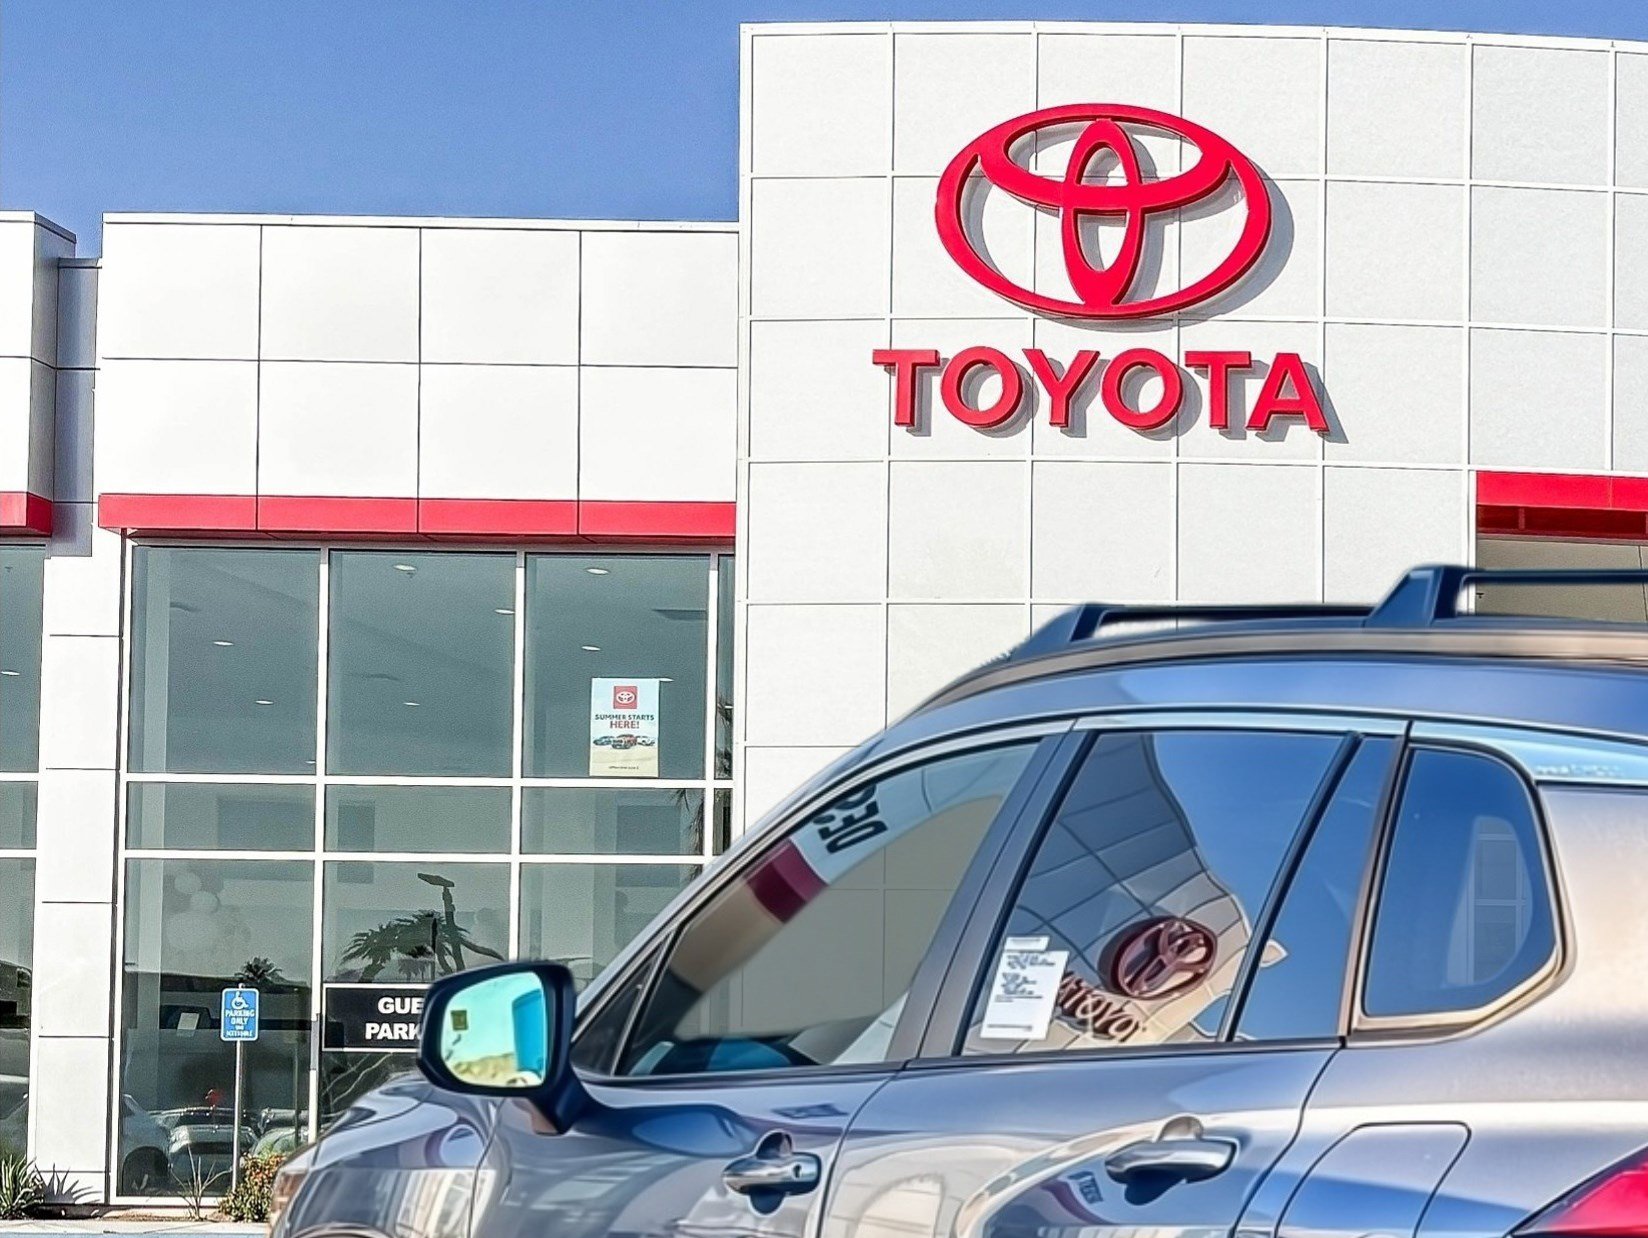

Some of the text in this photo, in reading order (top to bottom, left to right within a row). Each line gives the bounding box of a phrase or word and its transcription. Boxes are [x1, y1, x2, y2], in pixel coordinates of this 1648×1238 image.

[872, 345, 1329, 434] TOYOTA
[610, 720, 640, 729] HERE!
[377, 996, 424, 1015] GUE
[365, 1022, 422, 1040] PARK
